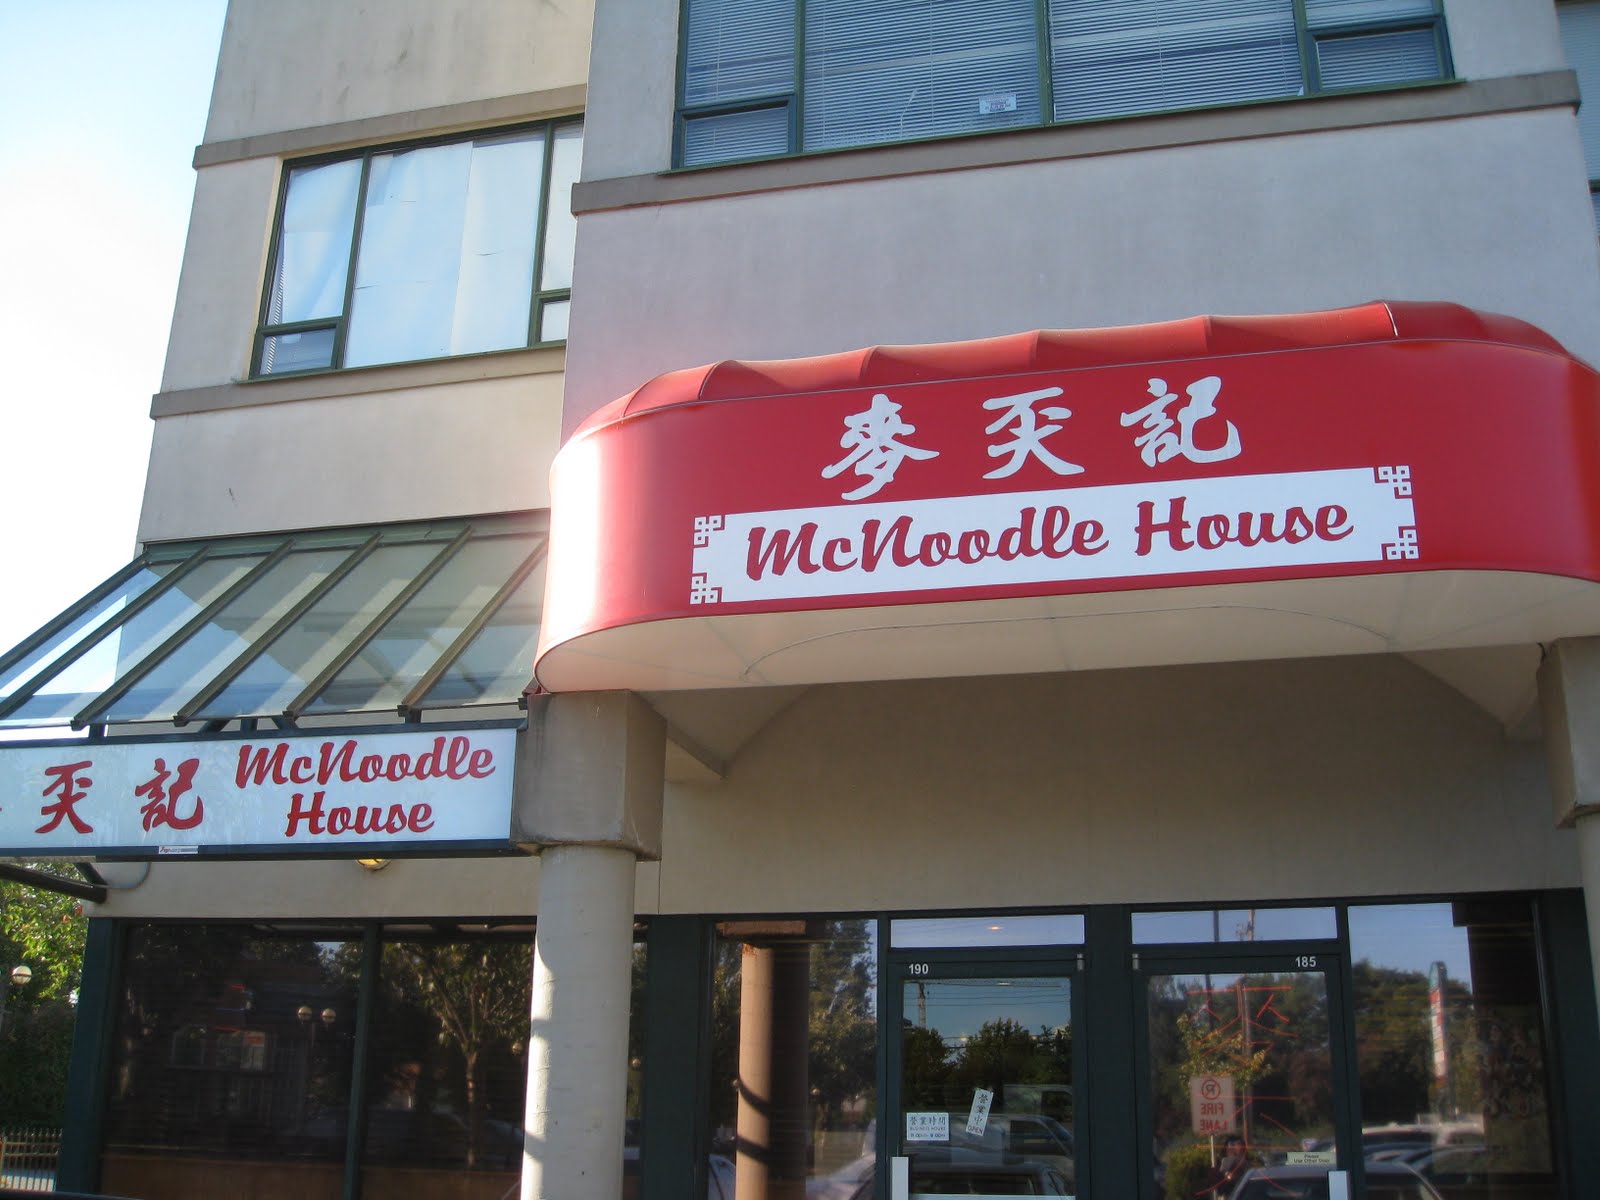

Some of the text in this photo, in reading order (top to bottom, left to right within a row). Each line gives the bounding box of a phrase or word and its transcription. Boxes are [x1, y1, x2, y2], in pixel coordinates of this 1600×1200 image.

[746, 496, 1353, 581] McNoodle House
[235, 736, 495, 788] McNoodle
[0, 758, 204, 833] 奀記
[286, 791, 434, 837] House
[908, 963, 929, 975] 190
[1295, 956, 1317, 968] 185
[967, 1125, 983, 1135] OPEN
